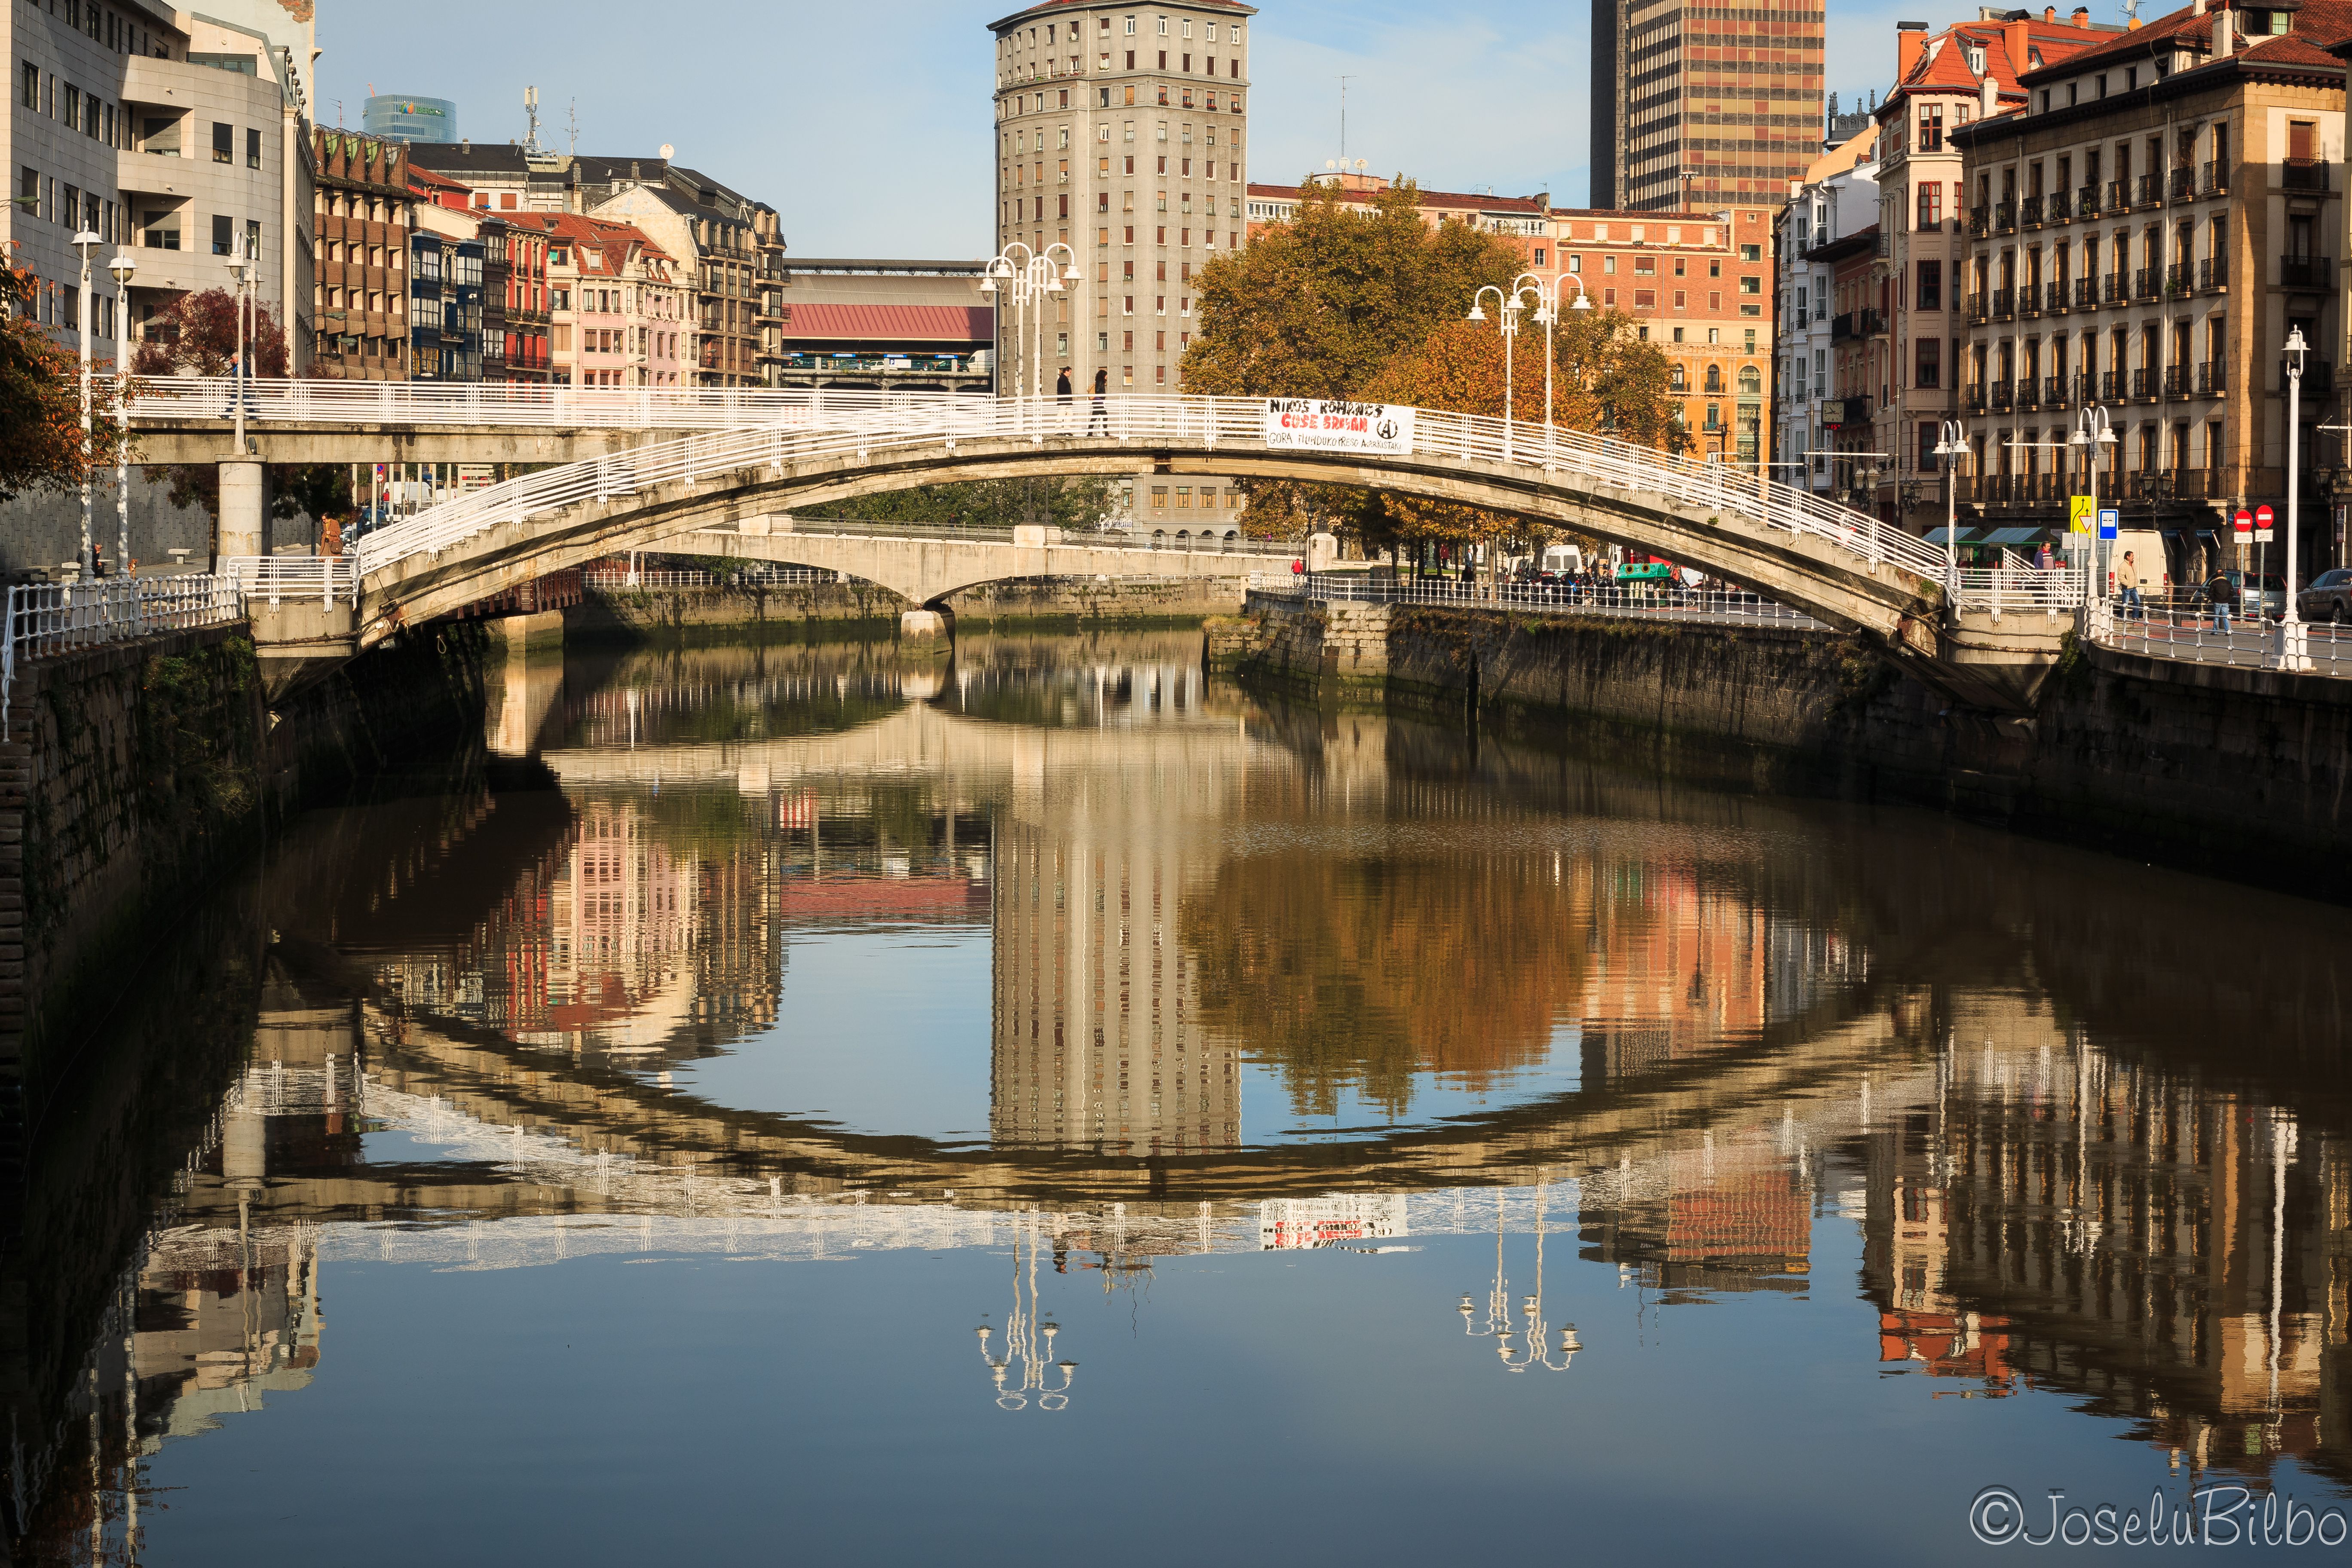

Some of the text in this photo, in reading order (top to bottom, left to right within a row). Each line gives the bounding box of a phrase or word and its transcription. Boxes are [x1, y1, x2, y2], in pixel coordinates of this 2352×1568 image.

[1270, 399, 1384, 418] NIKOS ROMANOS
[1269, 432, 1292, 444] GORA
